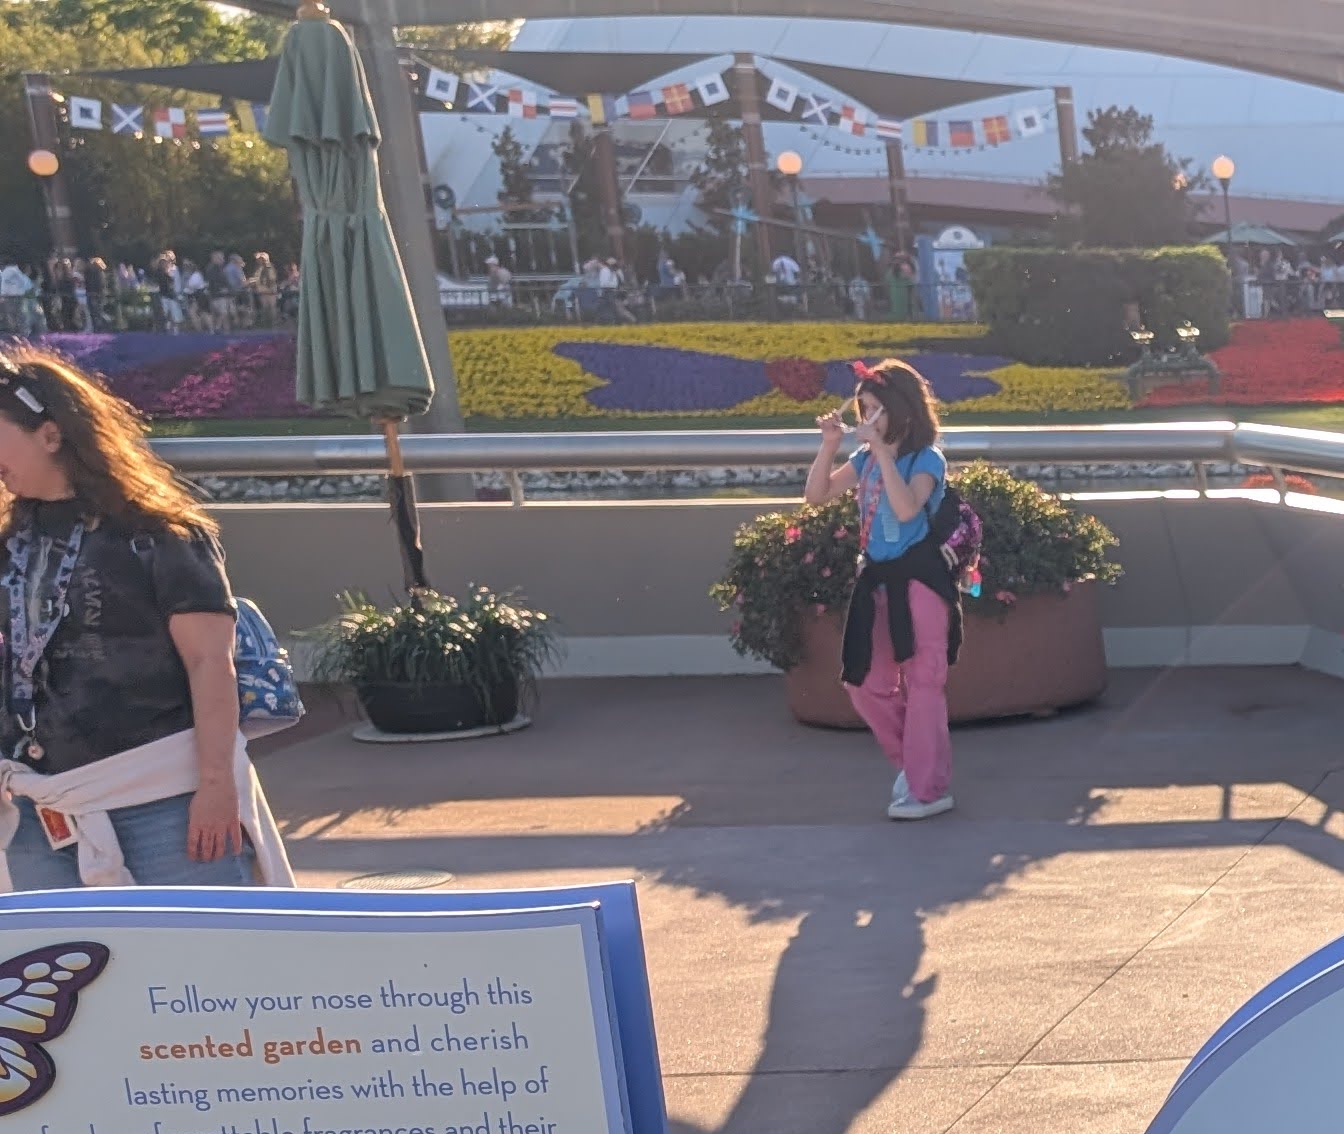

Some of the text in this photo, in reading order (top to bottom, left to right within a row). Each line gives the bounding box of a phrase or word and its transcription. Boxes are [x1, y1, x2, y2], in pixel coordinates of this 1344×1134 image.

[148, 976, 533, 1020] Follow your nose through this
[139, 1021, 529, 1065] scented garden and cherish
[124, 1065, 549, 1112] lasting memories with the help of
